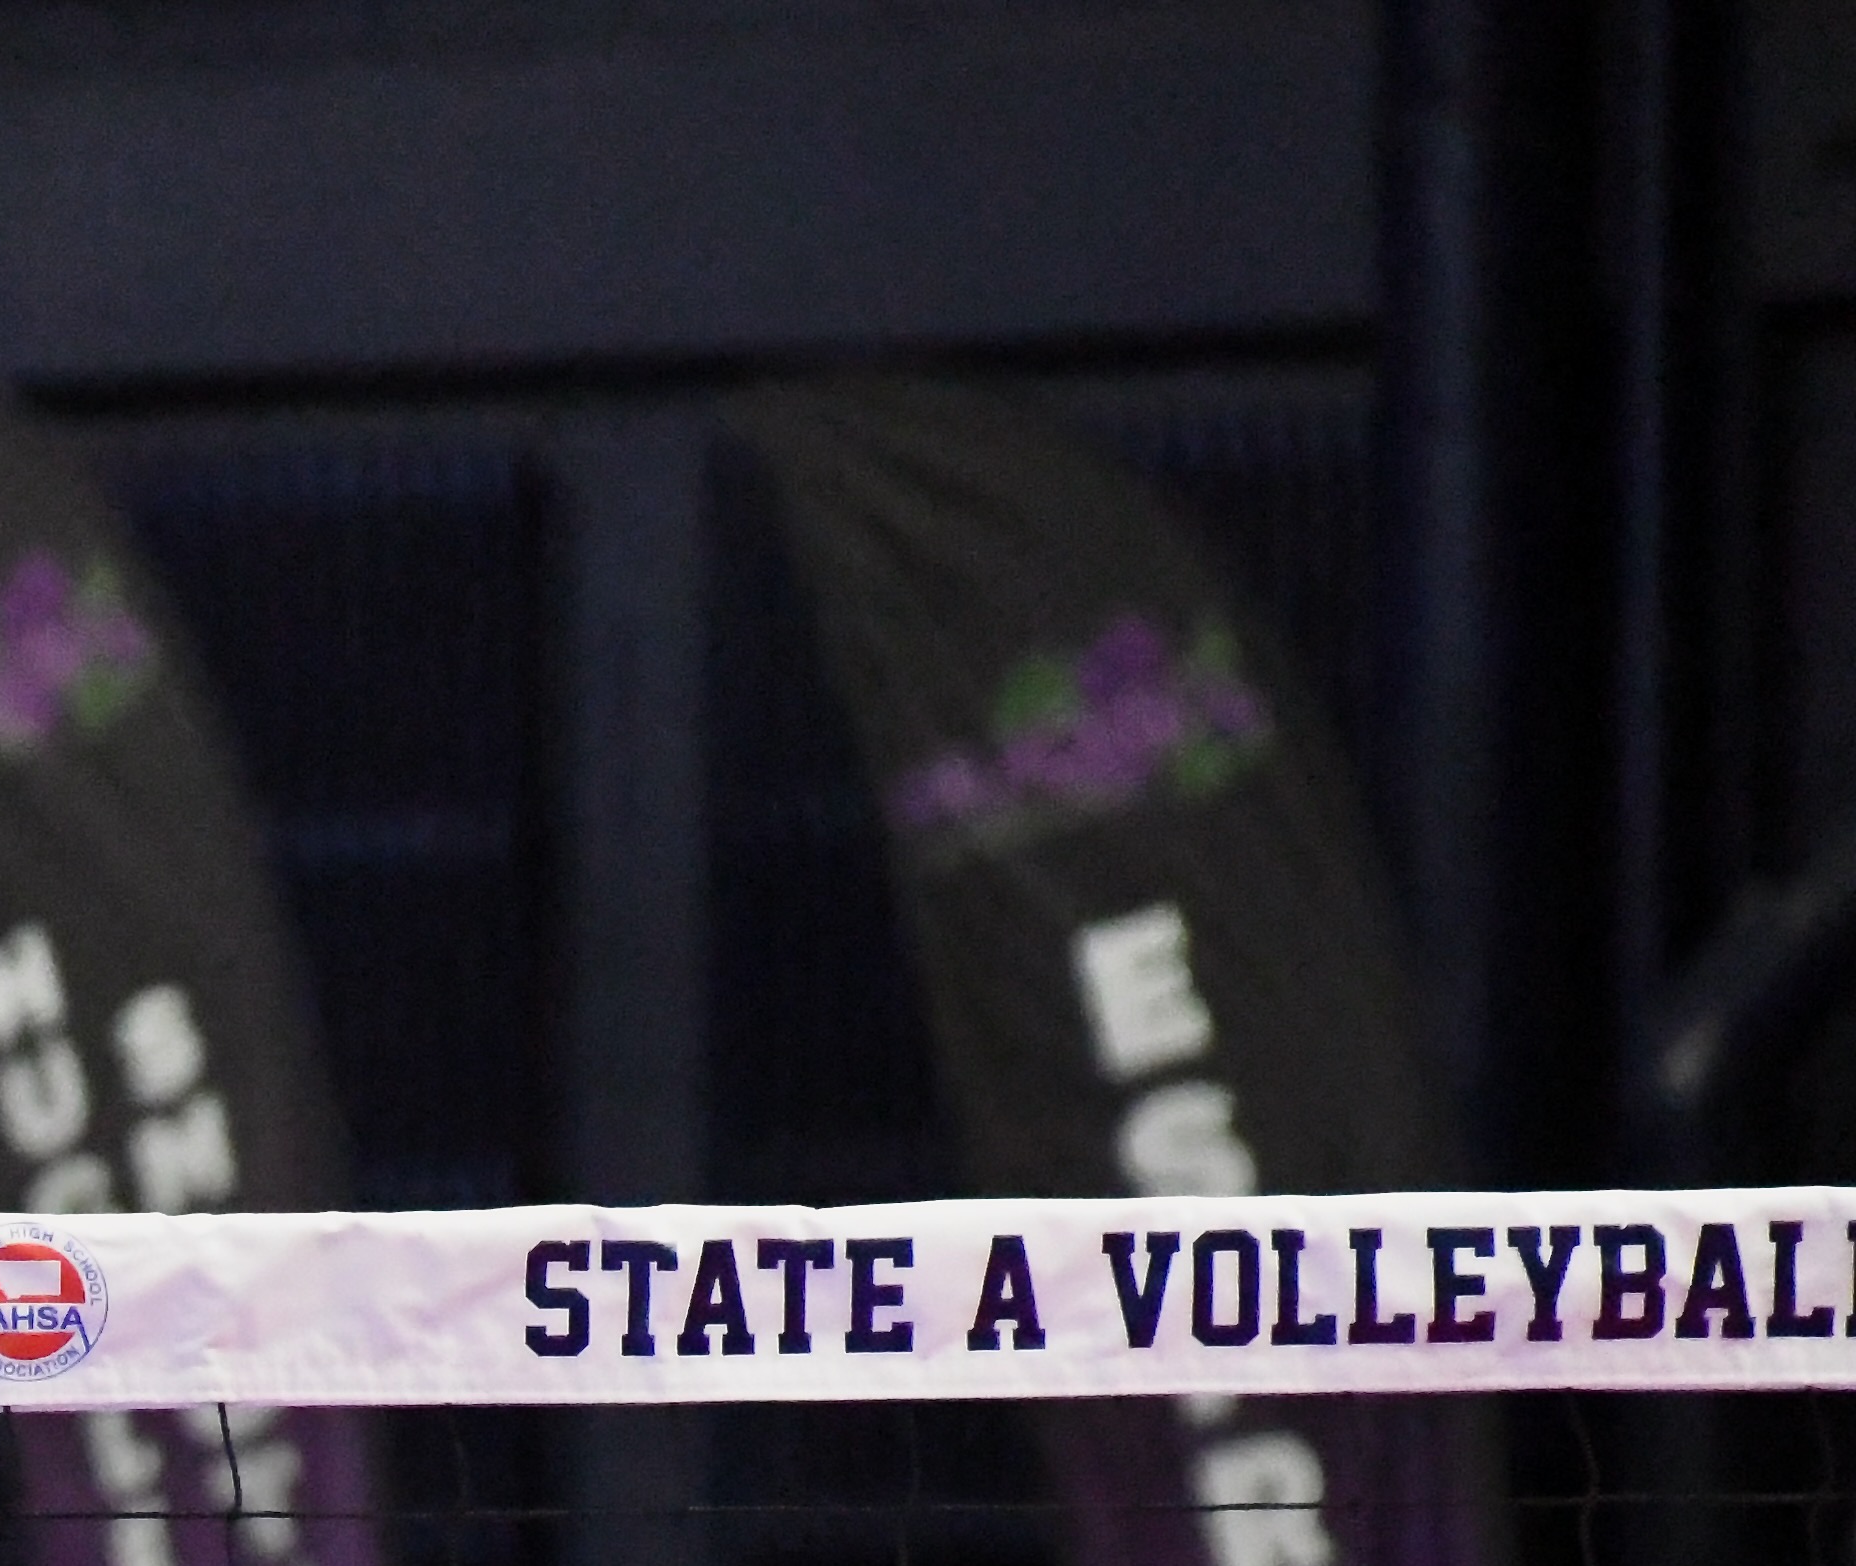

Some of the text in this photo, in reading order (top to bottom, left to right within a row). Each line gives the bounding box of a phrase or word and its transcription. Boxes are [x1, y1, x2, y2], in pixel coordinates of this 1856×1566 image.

[10, 1227, 55, 1243] HIGH
[63, 1240, 103, 1307] SCHOOL
[525, 1219, 1856, 1357] STATE A VOLLEYBAL
